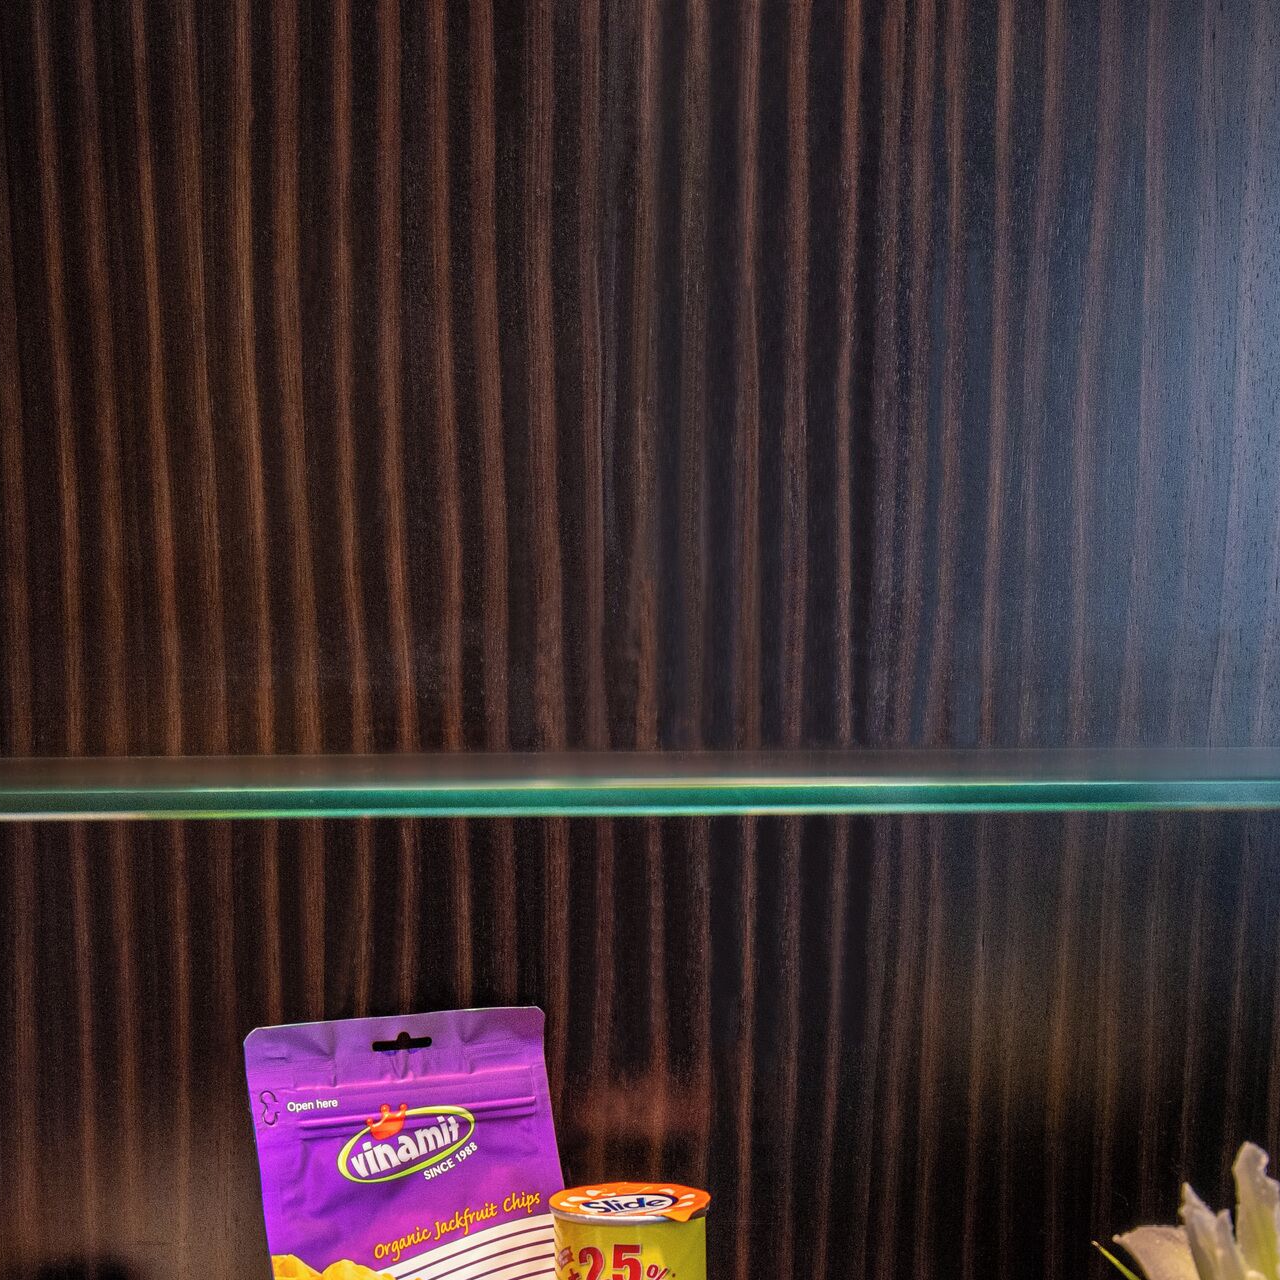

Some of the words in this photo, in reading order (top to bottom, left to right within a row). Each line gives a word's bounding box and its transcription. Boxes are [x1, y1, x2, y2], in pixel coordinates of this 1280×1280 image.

[287, 1102, 316, 1113] Open
[318, 1098, 338, 1110] here
[351, 1115, 460, 1178] vinamit
[423, 1157, 456, 1180] SINCE
[455, 1141, 478, 1163] 1988
[582, 1197, 665, 1213] Slide
[374, 1227, 432, 1262] Organic
[434, 1202, 498, 1240] Jackfruit
[503, 1191, 541, 1214] Chips
